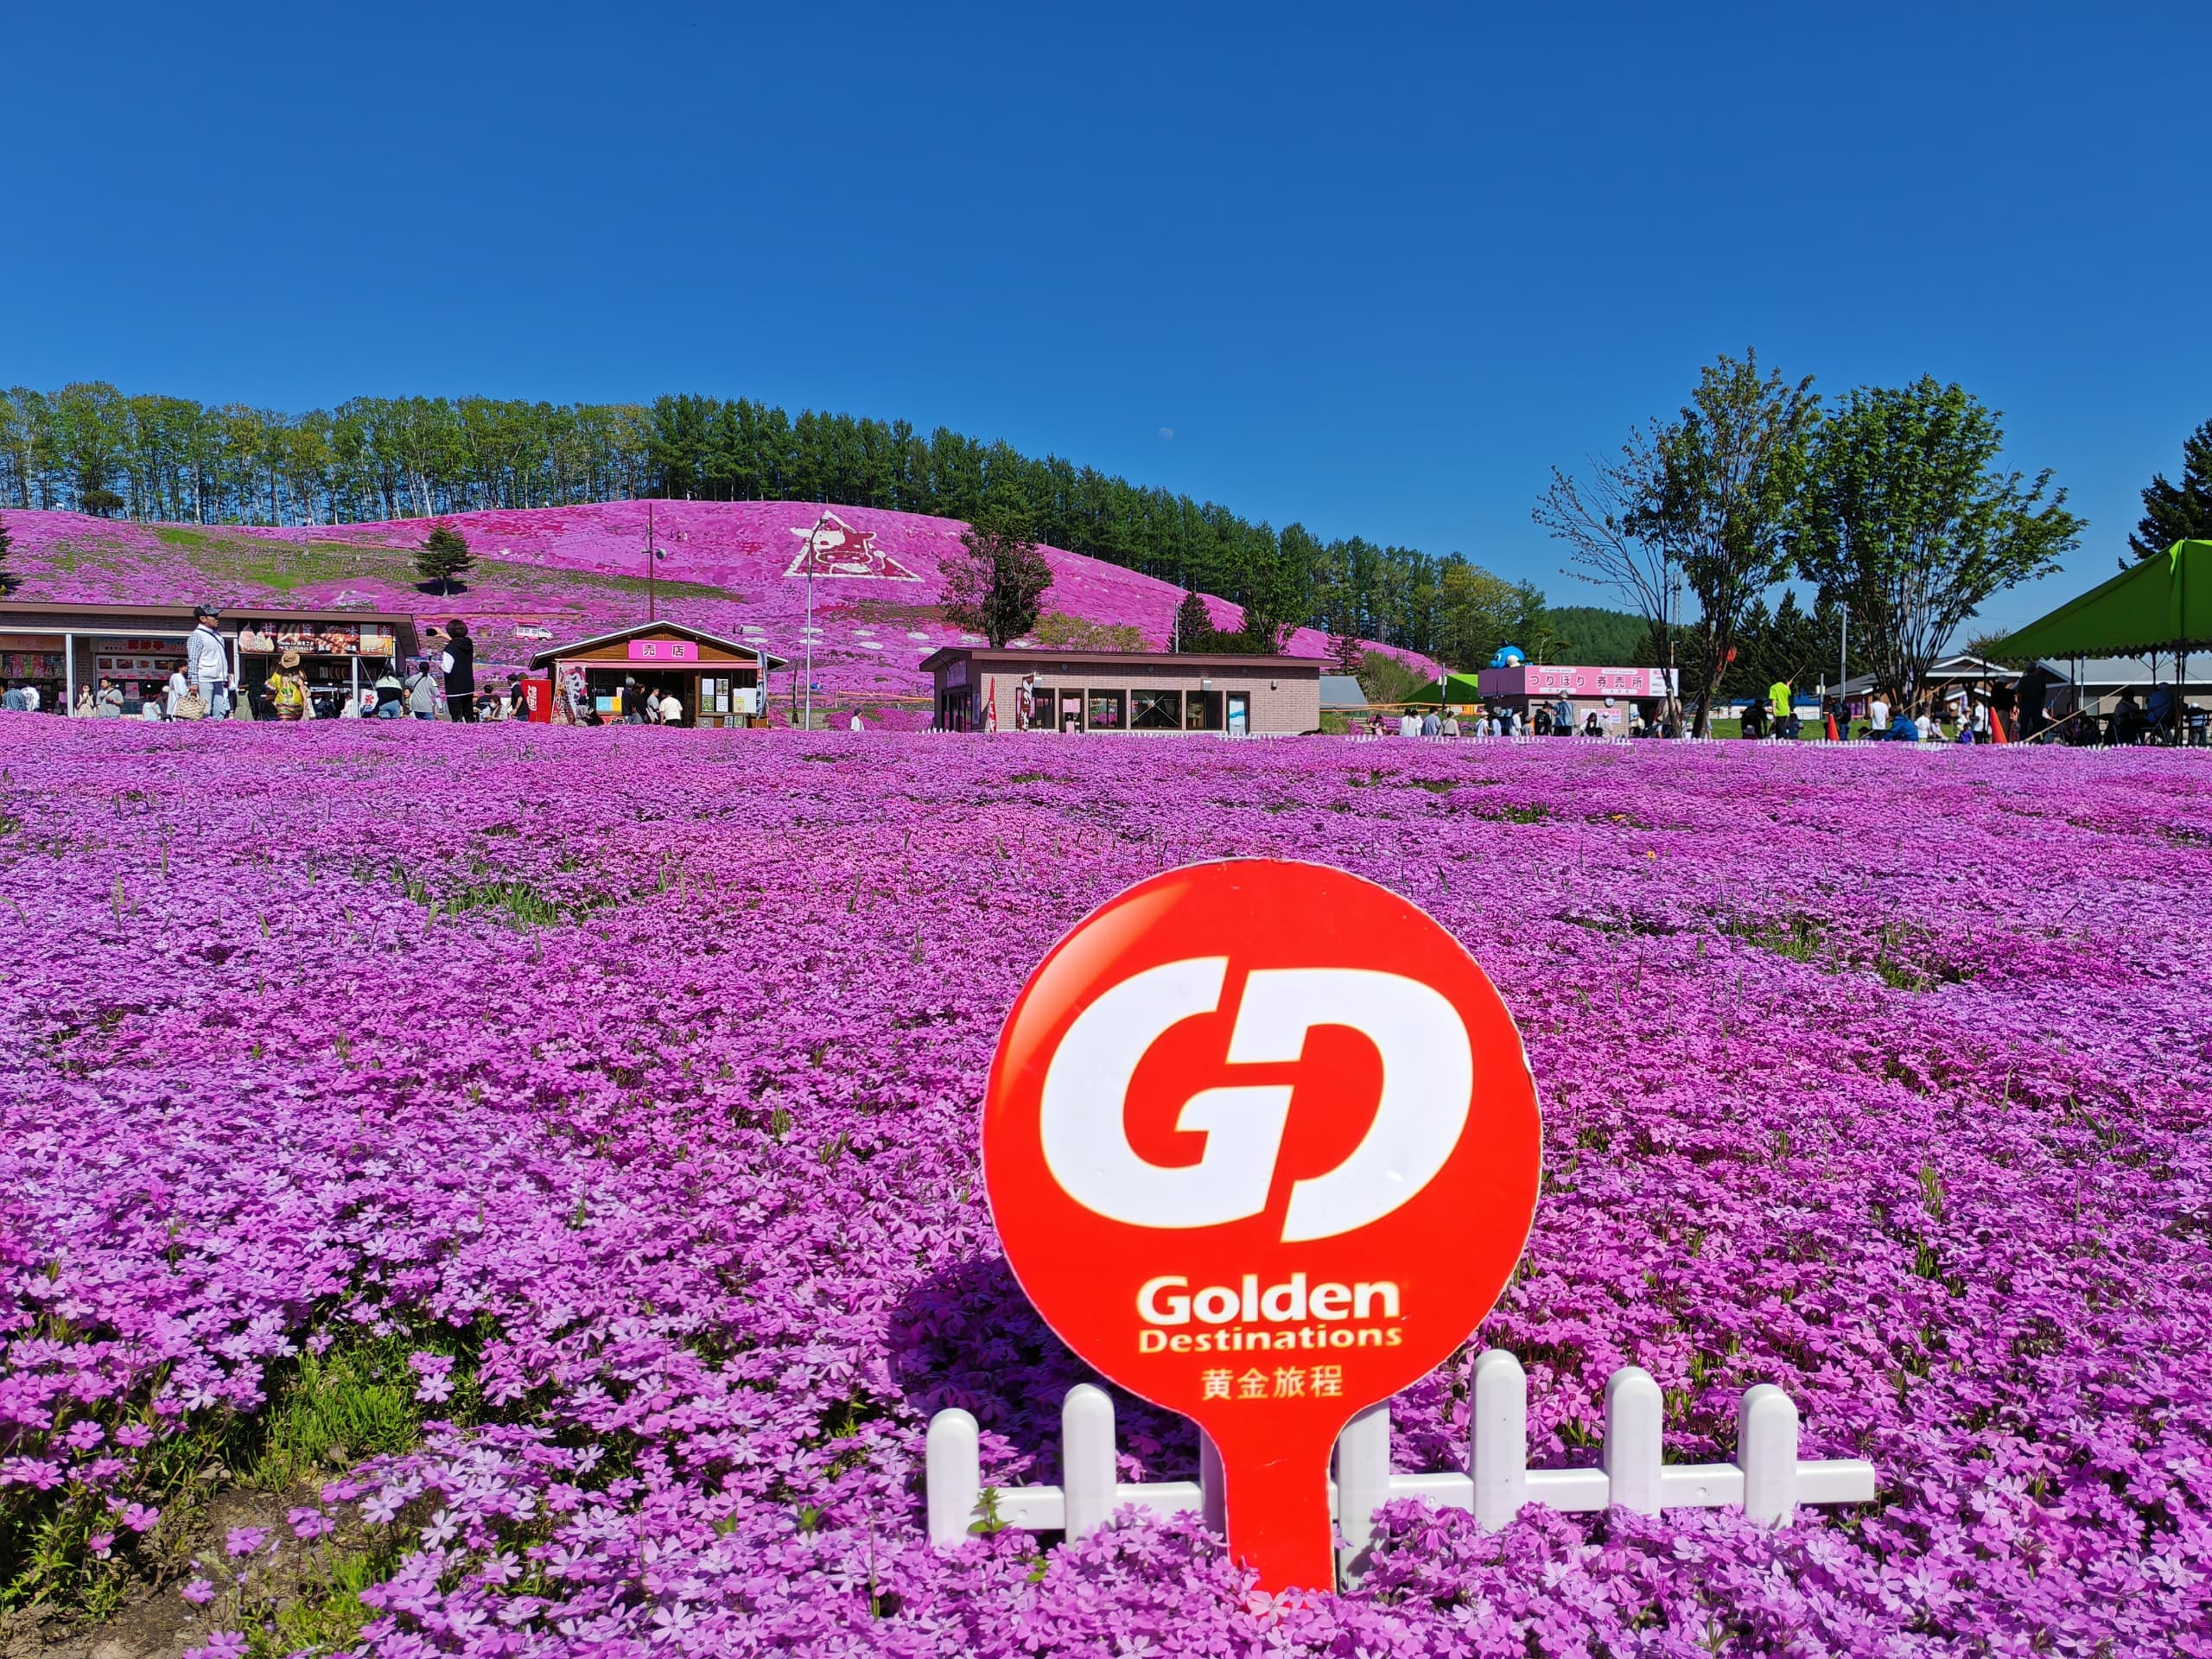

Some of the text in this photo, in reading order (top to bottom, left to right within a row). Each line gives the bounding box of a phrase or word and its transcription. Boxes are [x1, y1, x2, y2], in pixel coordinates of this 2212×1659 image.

[642, 644, 685, 657] 売店
[1596, 676, 1643, 688] 券売所
[1039, 955, 1474, 1243] GD
[1135, 1272, 1401, 1325] Golden
[1138, 1324, 1403, 1355] Destinations
[1201, 1364, 1344, 1402] 黄金旅程
